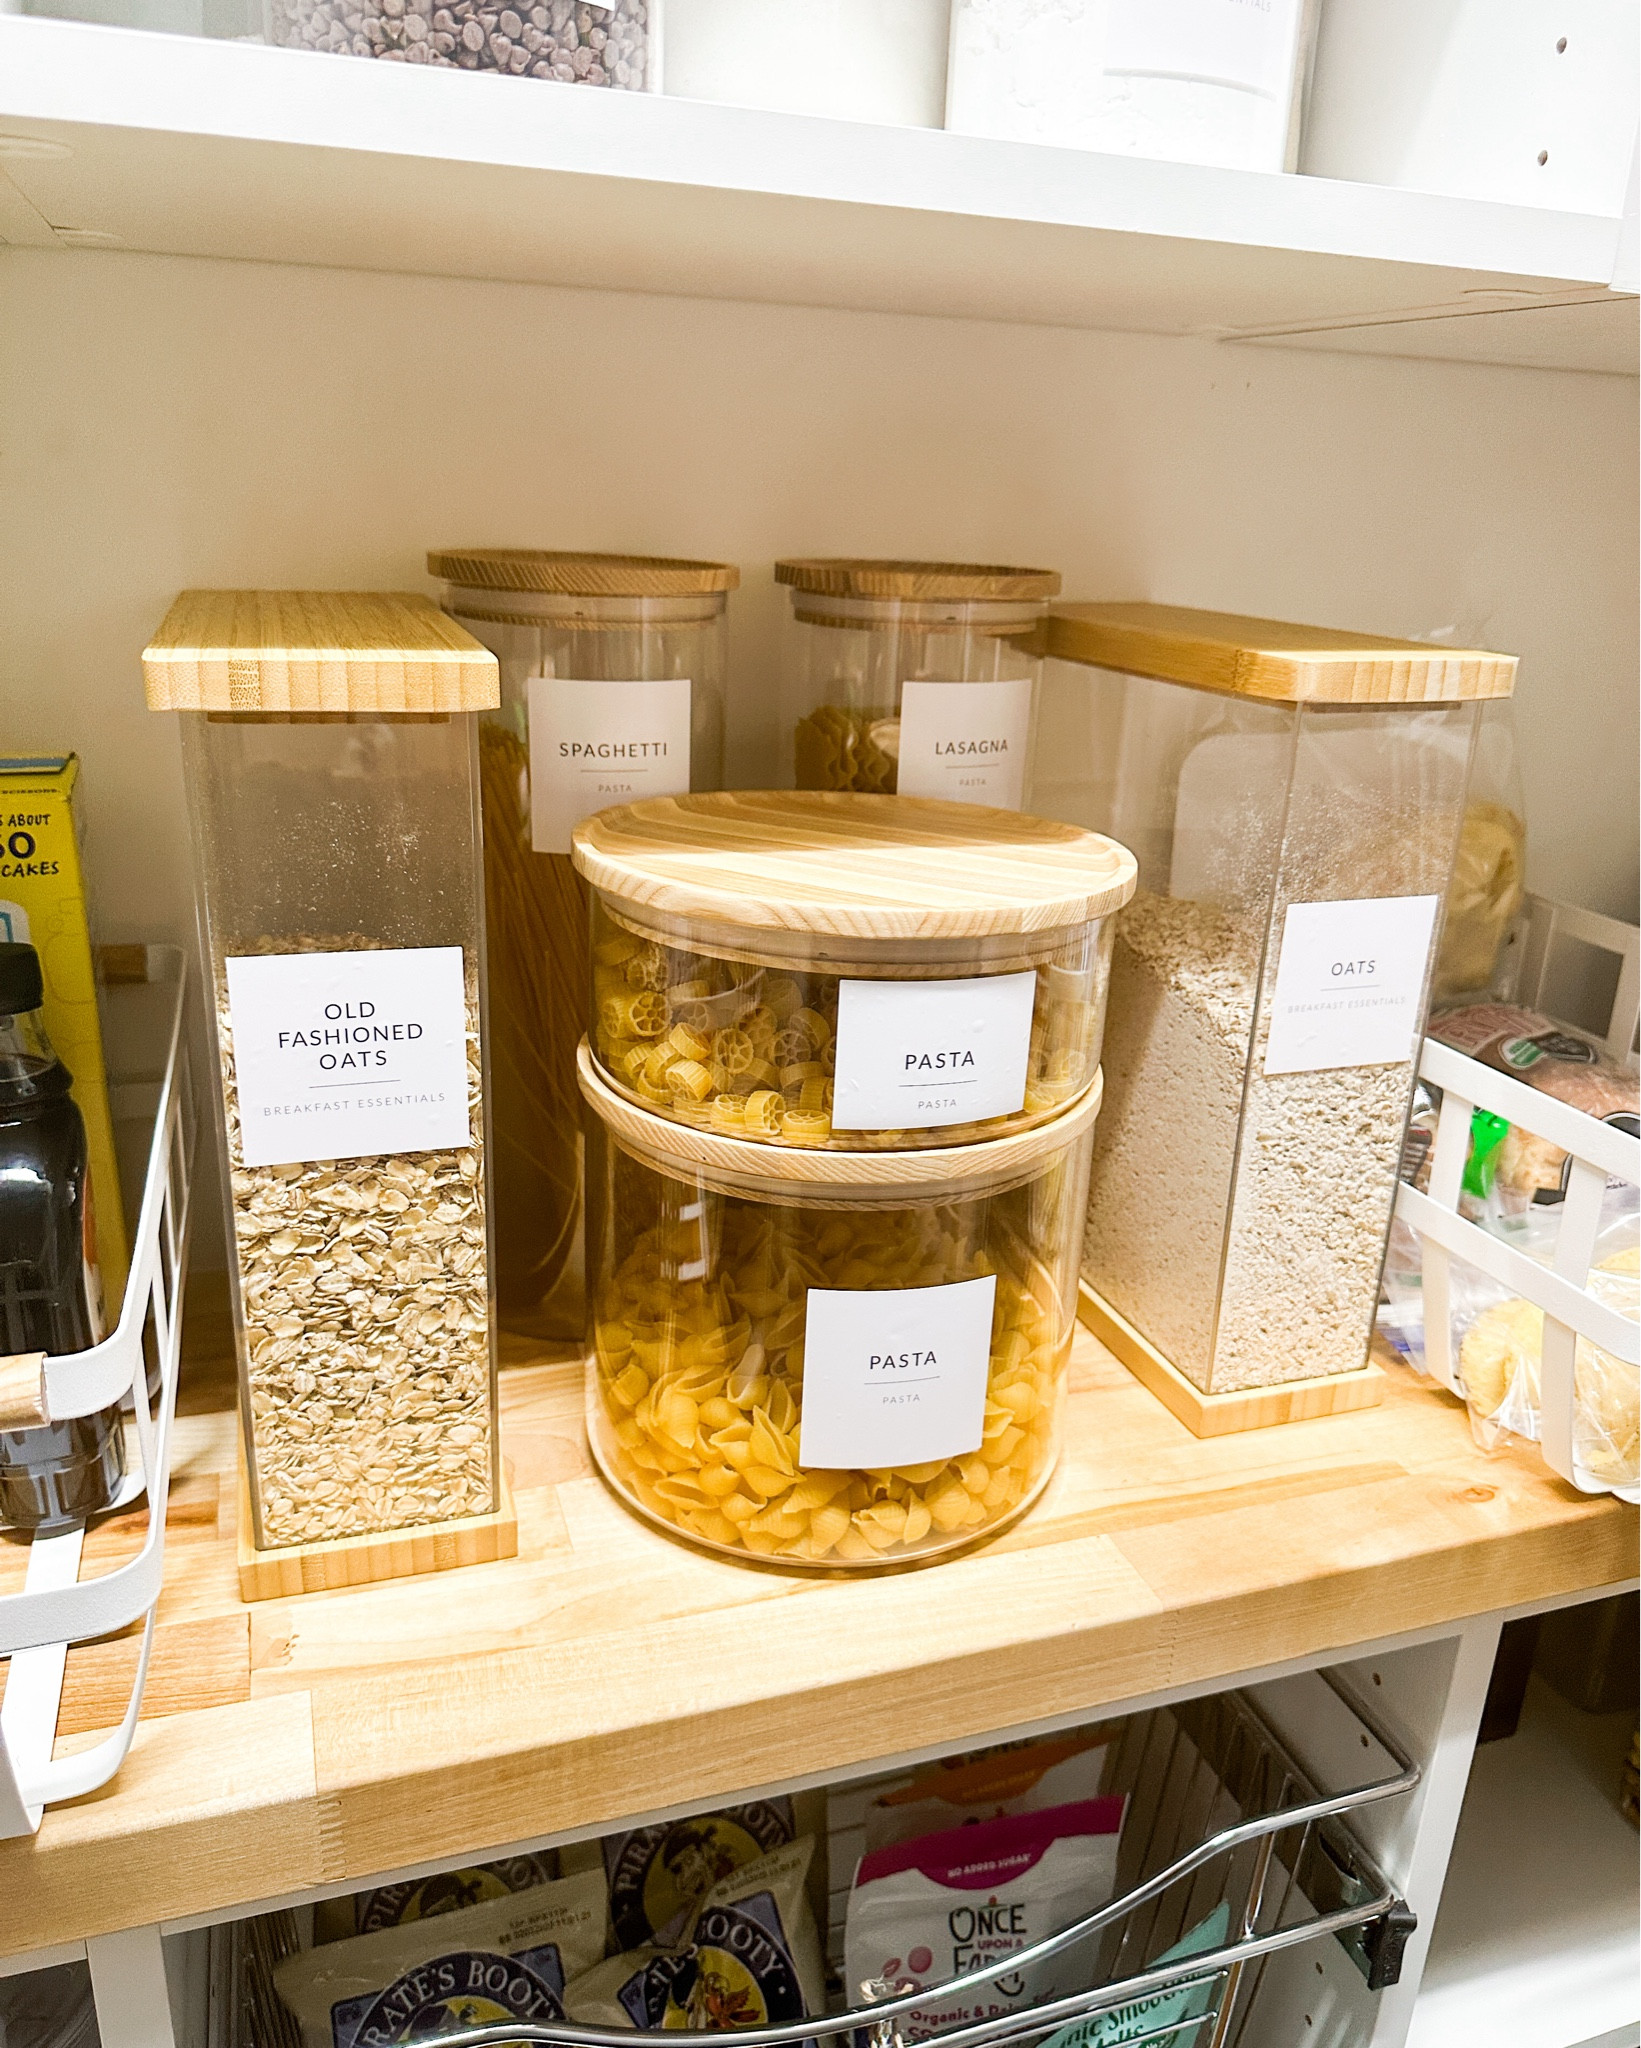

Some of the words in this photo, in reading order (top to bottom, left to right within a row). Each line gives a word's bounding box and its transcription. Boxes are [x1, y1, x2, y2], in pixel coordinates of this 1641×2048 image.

[559, 742, 668, 758] SPAGHETTI
[935, 739, 1009, 755] LASAGNA
[598, 784, 633, 793] PASTA
[959, 778, 987, 787] PASTA
[8, 814, 51, 828] ABOUT
[0, 831, 36, 859] 0
[1, 861, 60, 878] CAKES
[1331, 960, 1376, 976] OATS
[324, 1001, 376, 1020] OLD
[1287, 1001, 1344, 1014] BREAKFAST
[1347, 996, 1406, 1009] ESSENTIALS
[278, 1023, 424, 1048] FASHIONED
[319, 1050, 388, 1070] OATS
[905, 1050, 975, 1070] PASTA
[264, 1100, 350, 1117] BREAKFAST
[357, 1092, 446, 1109] ESSENTIALS
[918, 1098, 957, 1110] PASTA
[870, 1350, 937, 1370] PASTA
[882, 1393, 921, 1405] PASTA
[949, 1903, 1028, 1942] ONCE
[702, 1913, 785, 1978] OOTY
[977, 1938, 1013, 1950] UPON
[1015, 1938, 1024, 1947] A
[910, 2007, 970, 2026] Organic
[973, 2005, 984, 2018] &
